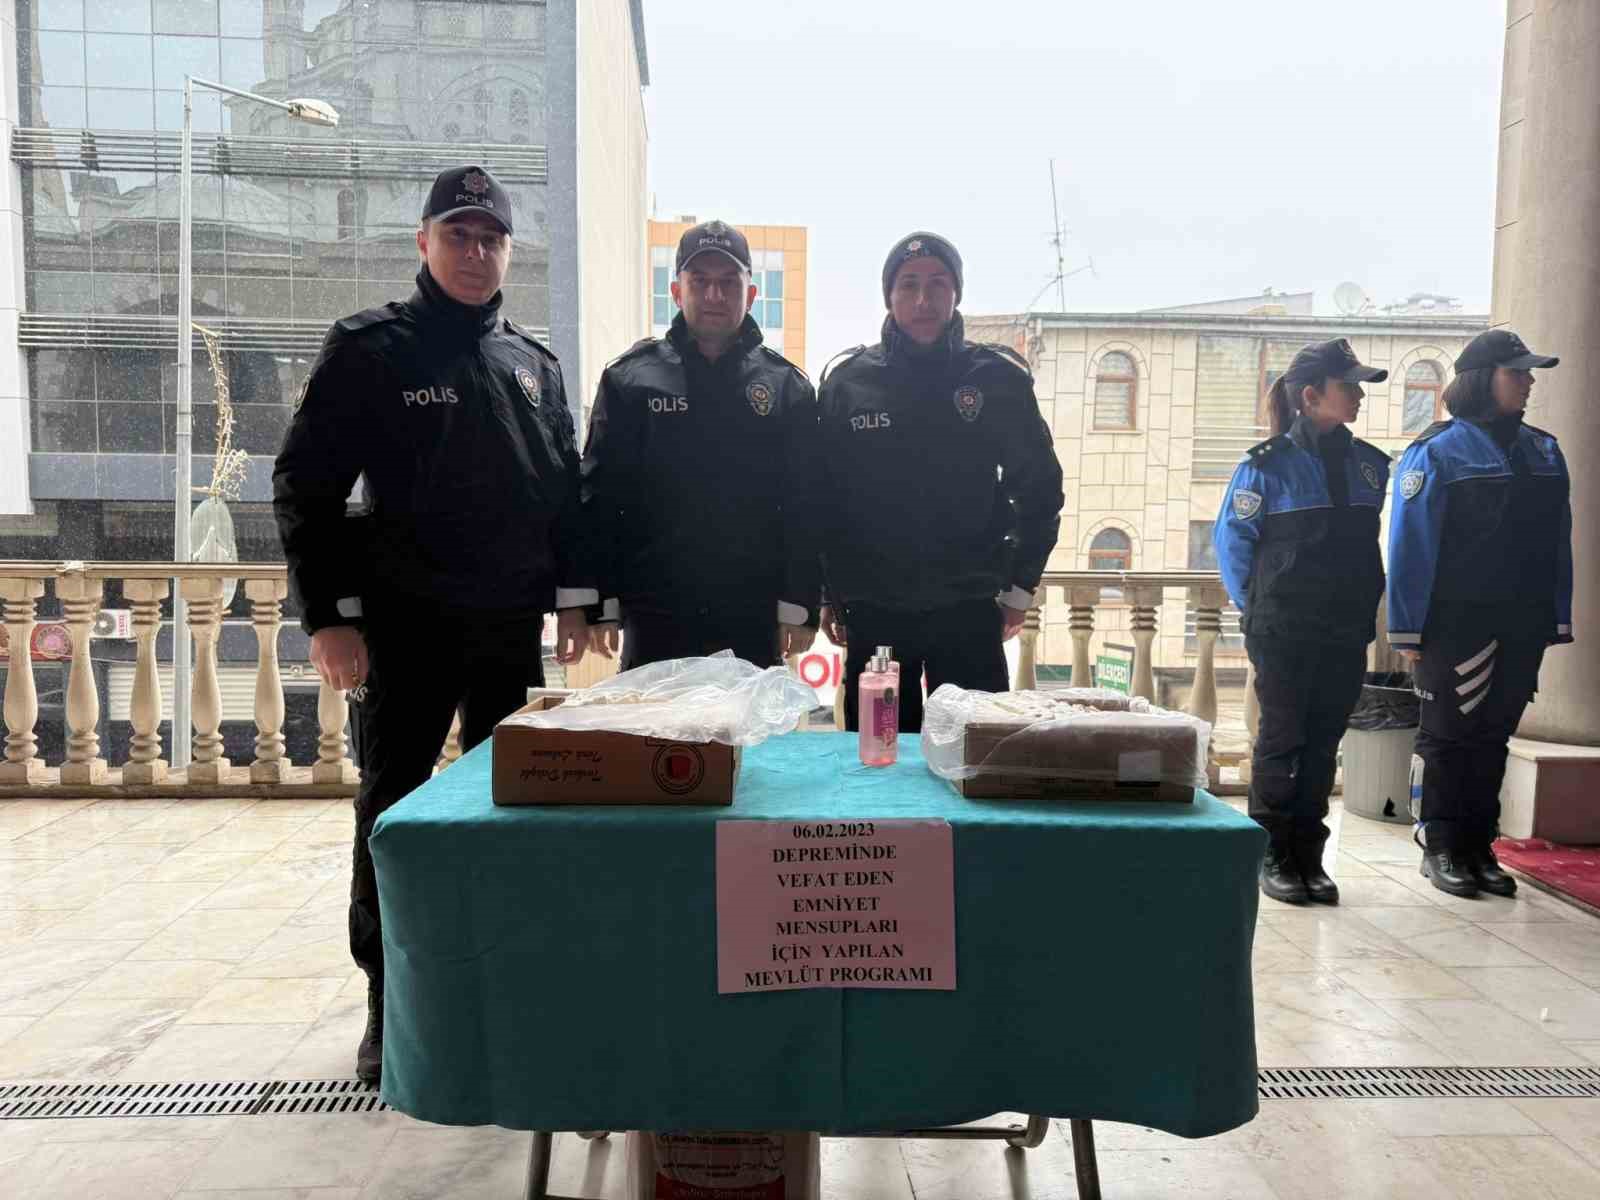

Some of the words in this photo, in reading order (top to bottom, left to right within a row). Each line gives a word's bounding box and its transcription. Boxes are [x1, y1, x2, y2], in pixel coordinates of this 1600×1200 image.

[793, 823, 875, 839] 06.02.2023
[773, 843, 897, 863] DEPREMİNDE
[777, 872, 838, 888] VEFAT
[844, 870, 895, 887] EDEN
[793, 895, 880, 913] EMNİYET
[776, 919, 898, 936] MENSUPLARI
[772, 943, 811, 964] İÇİN
[822, 943, 904, 959] YAPILAN
[744, 965, 824, 987] MEVLÜT
[830, 967, 933, 983] PROGRAMI
